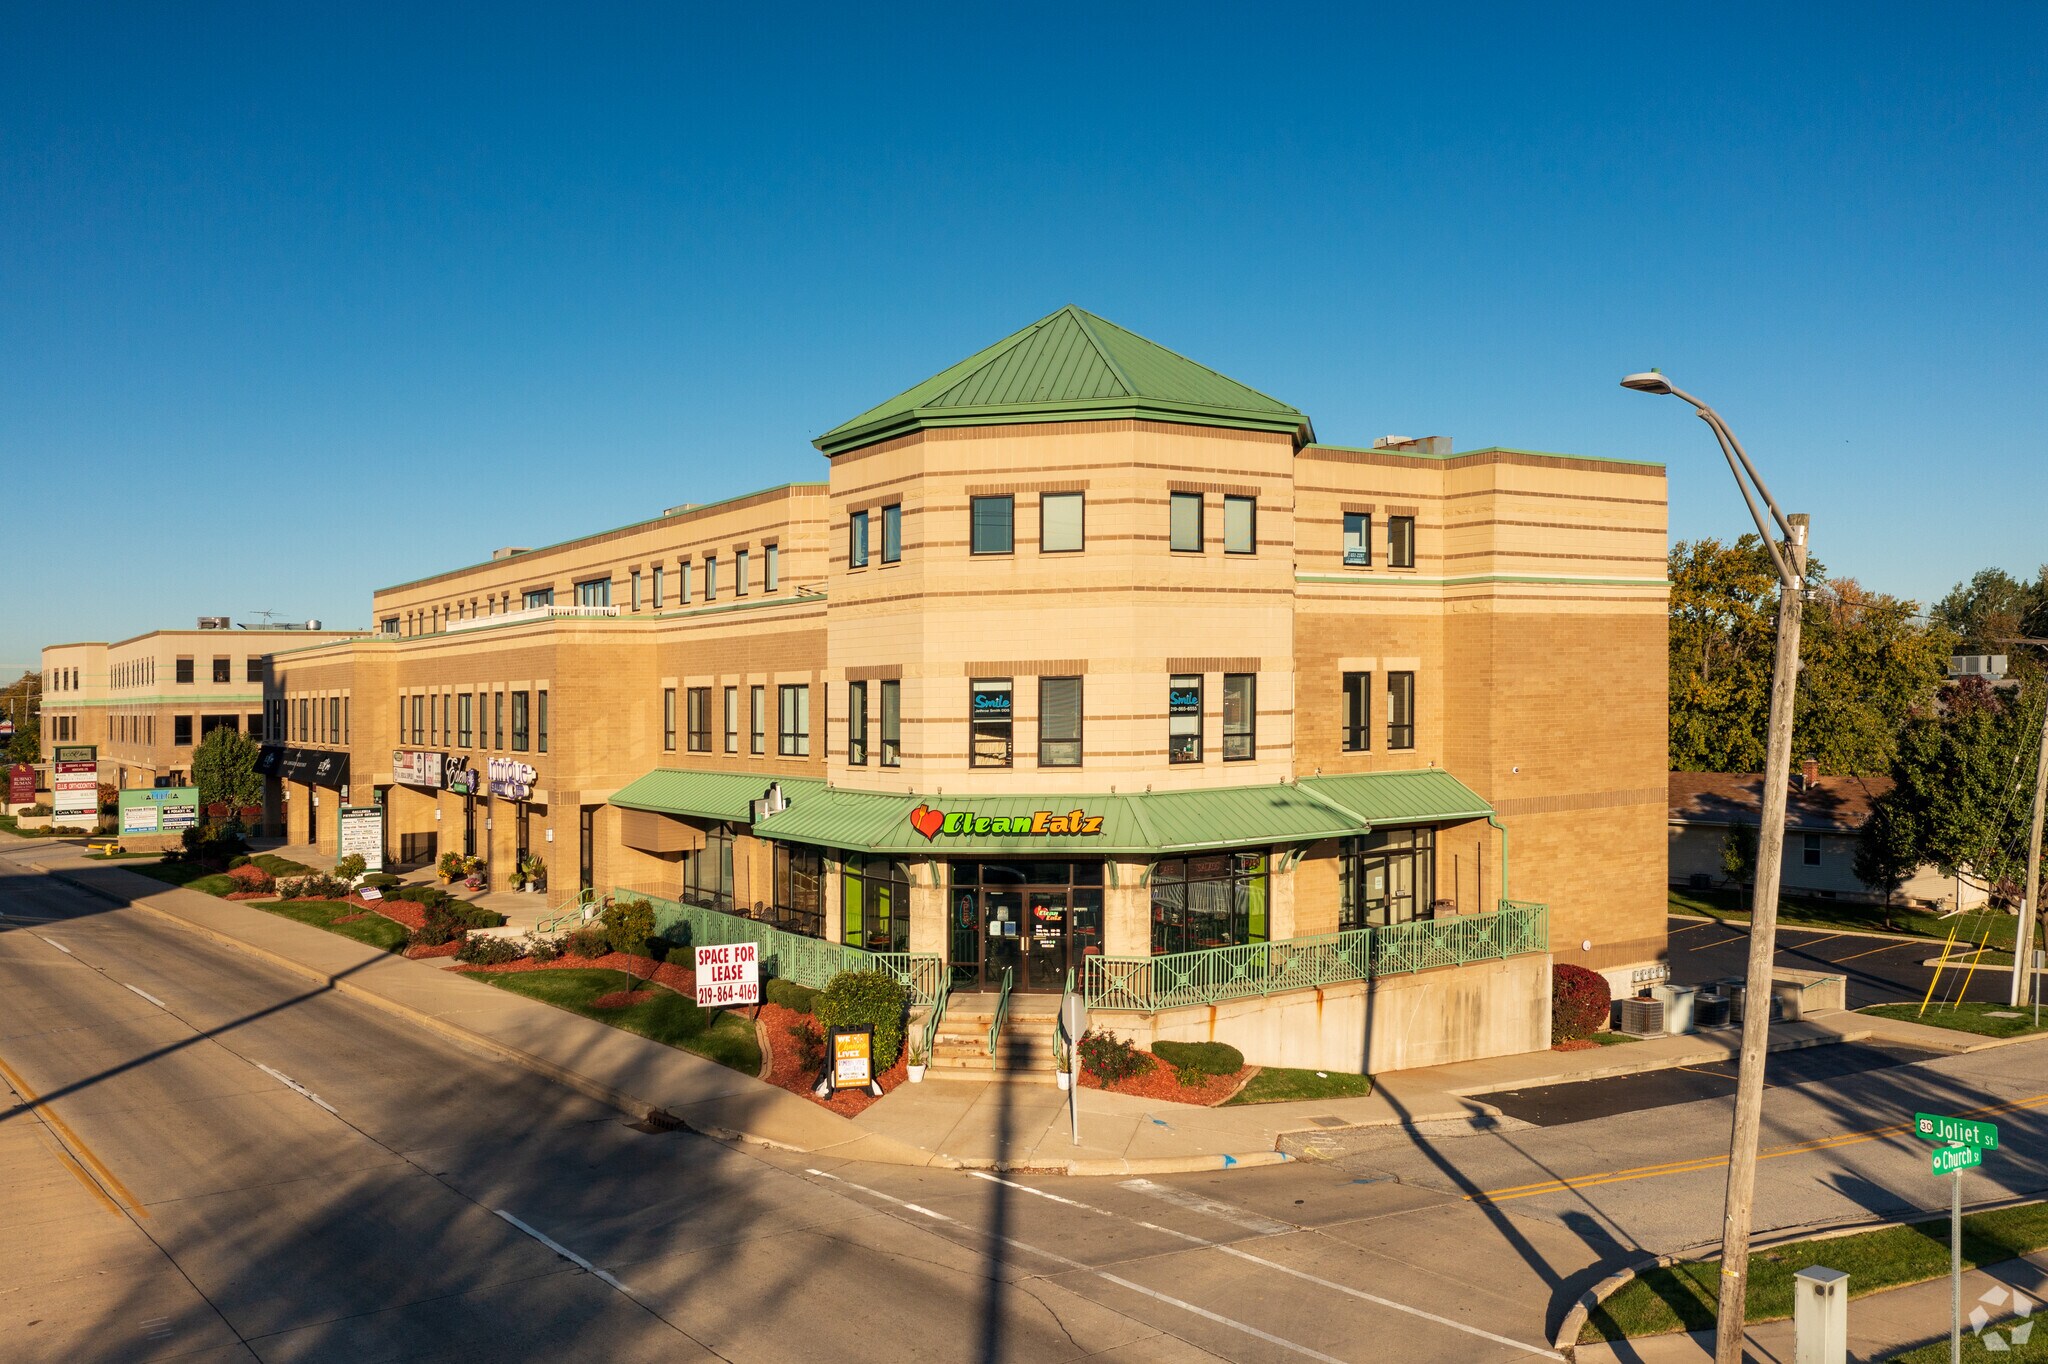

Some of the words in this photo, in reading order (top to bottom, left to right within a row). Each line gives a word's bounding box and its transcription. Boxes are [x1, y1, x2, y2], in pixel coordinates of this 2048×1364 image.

[975, 694, 1010, 708] Smile
[1170, 691, 1198, 705] Smile
[699, 948, 729, 966] SPACE
[735, 946, 754, 962] FOR
[712, 964, 743, 982] LEASE
[699, 983, 757, 1004] 219-864-4169
[837, 1035, 850, 1043] WE
[1921, 1121, 1932, 1131] 30
[1936, 1120, 1979, 1143] Joliet
[1985, 1135, 1994, 1146] St
[1943, 1147, 1972, 1169] Church
